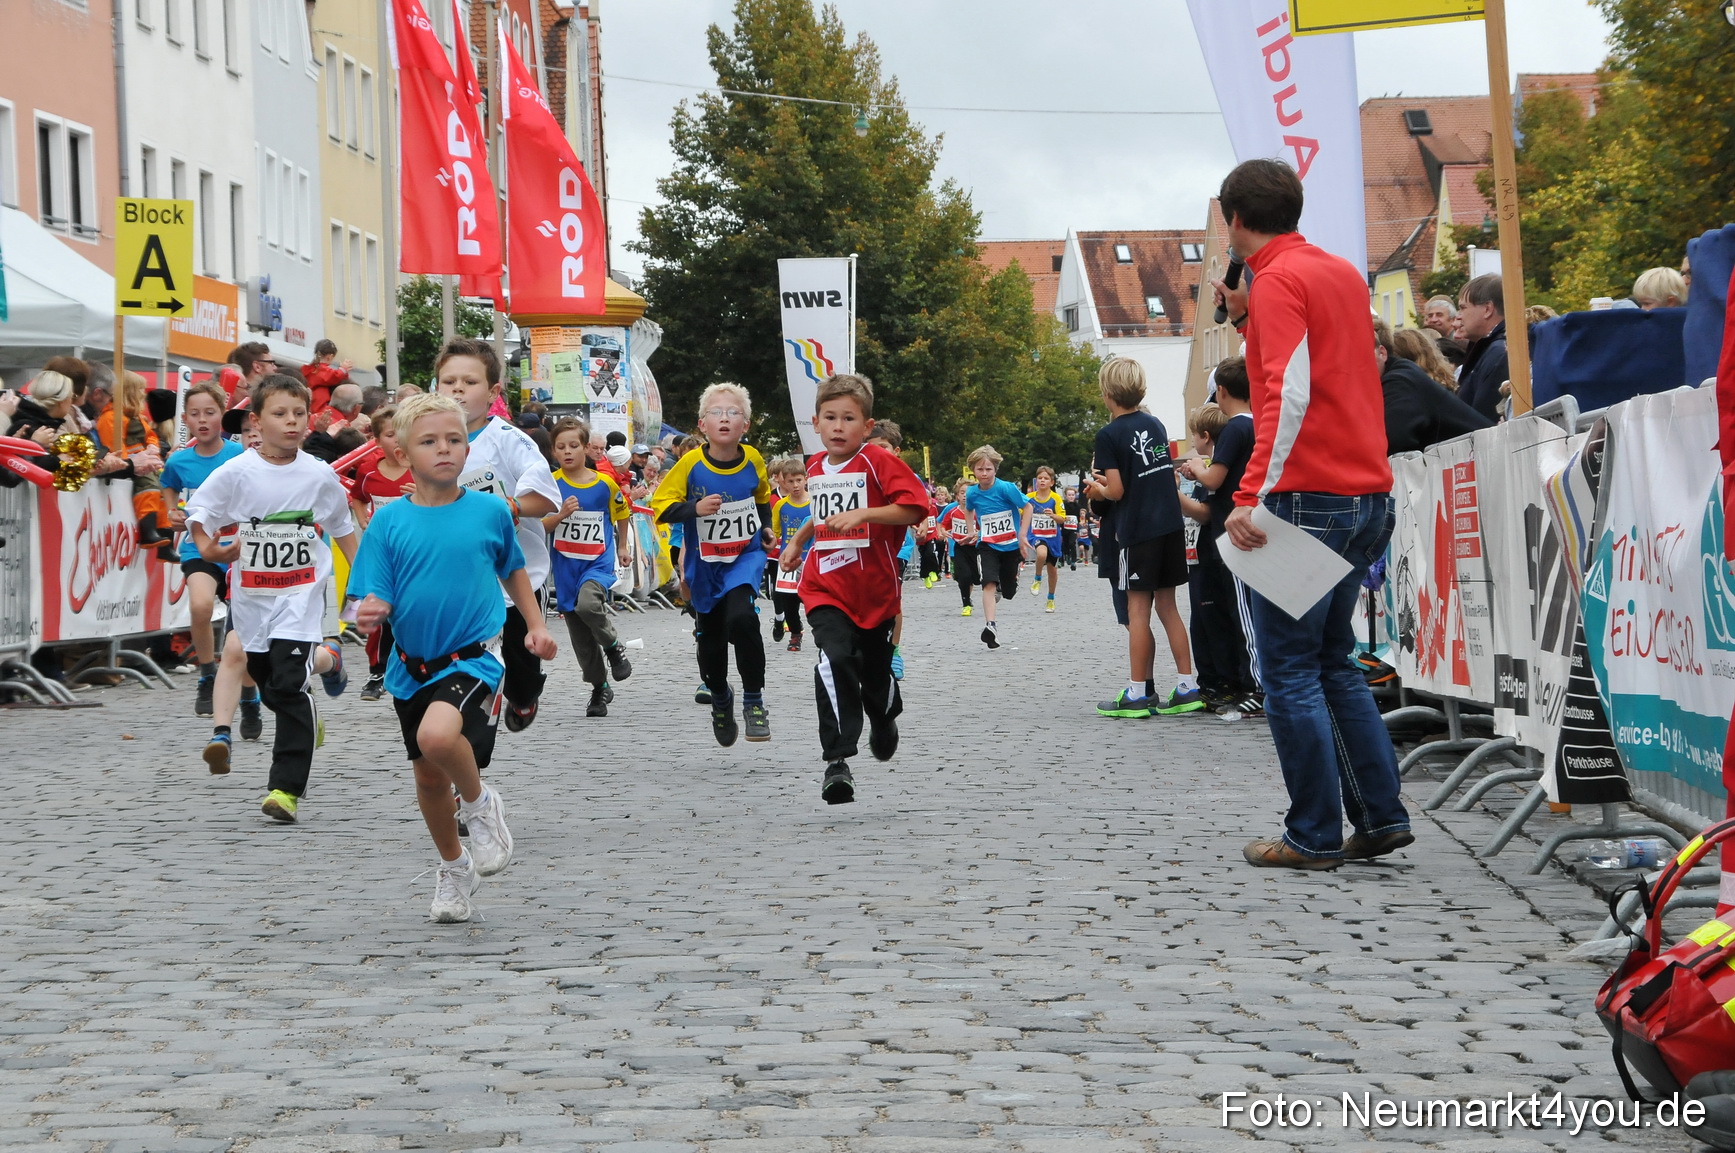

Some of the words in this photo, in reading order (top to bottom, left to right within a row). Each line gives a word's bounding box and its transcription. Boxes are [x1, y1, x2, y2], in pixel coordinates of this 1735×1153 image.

[124, 202, 184, 225] Block
[130, 234, 176, 291] A
[821, 481, 853, 490] Neumarkt
[721, 505, 750, 515] Neumarkt
[560, 521, 601, 541] 7572
[703, 513, 757, 540] 7216
[954, 523, 968, 534] 716
[984, 519, 1012, 535] 7542
[1034, 520, 1055, 529] 7514
[240, 530, 264, 539] PARTL
[266, 531, 304, 539] Neumarkt
[246, 541, 311, 568] 7026
[254, 573, 301, 587] Christoph
[1567, 756, 1615, 769] Parkhäuser
